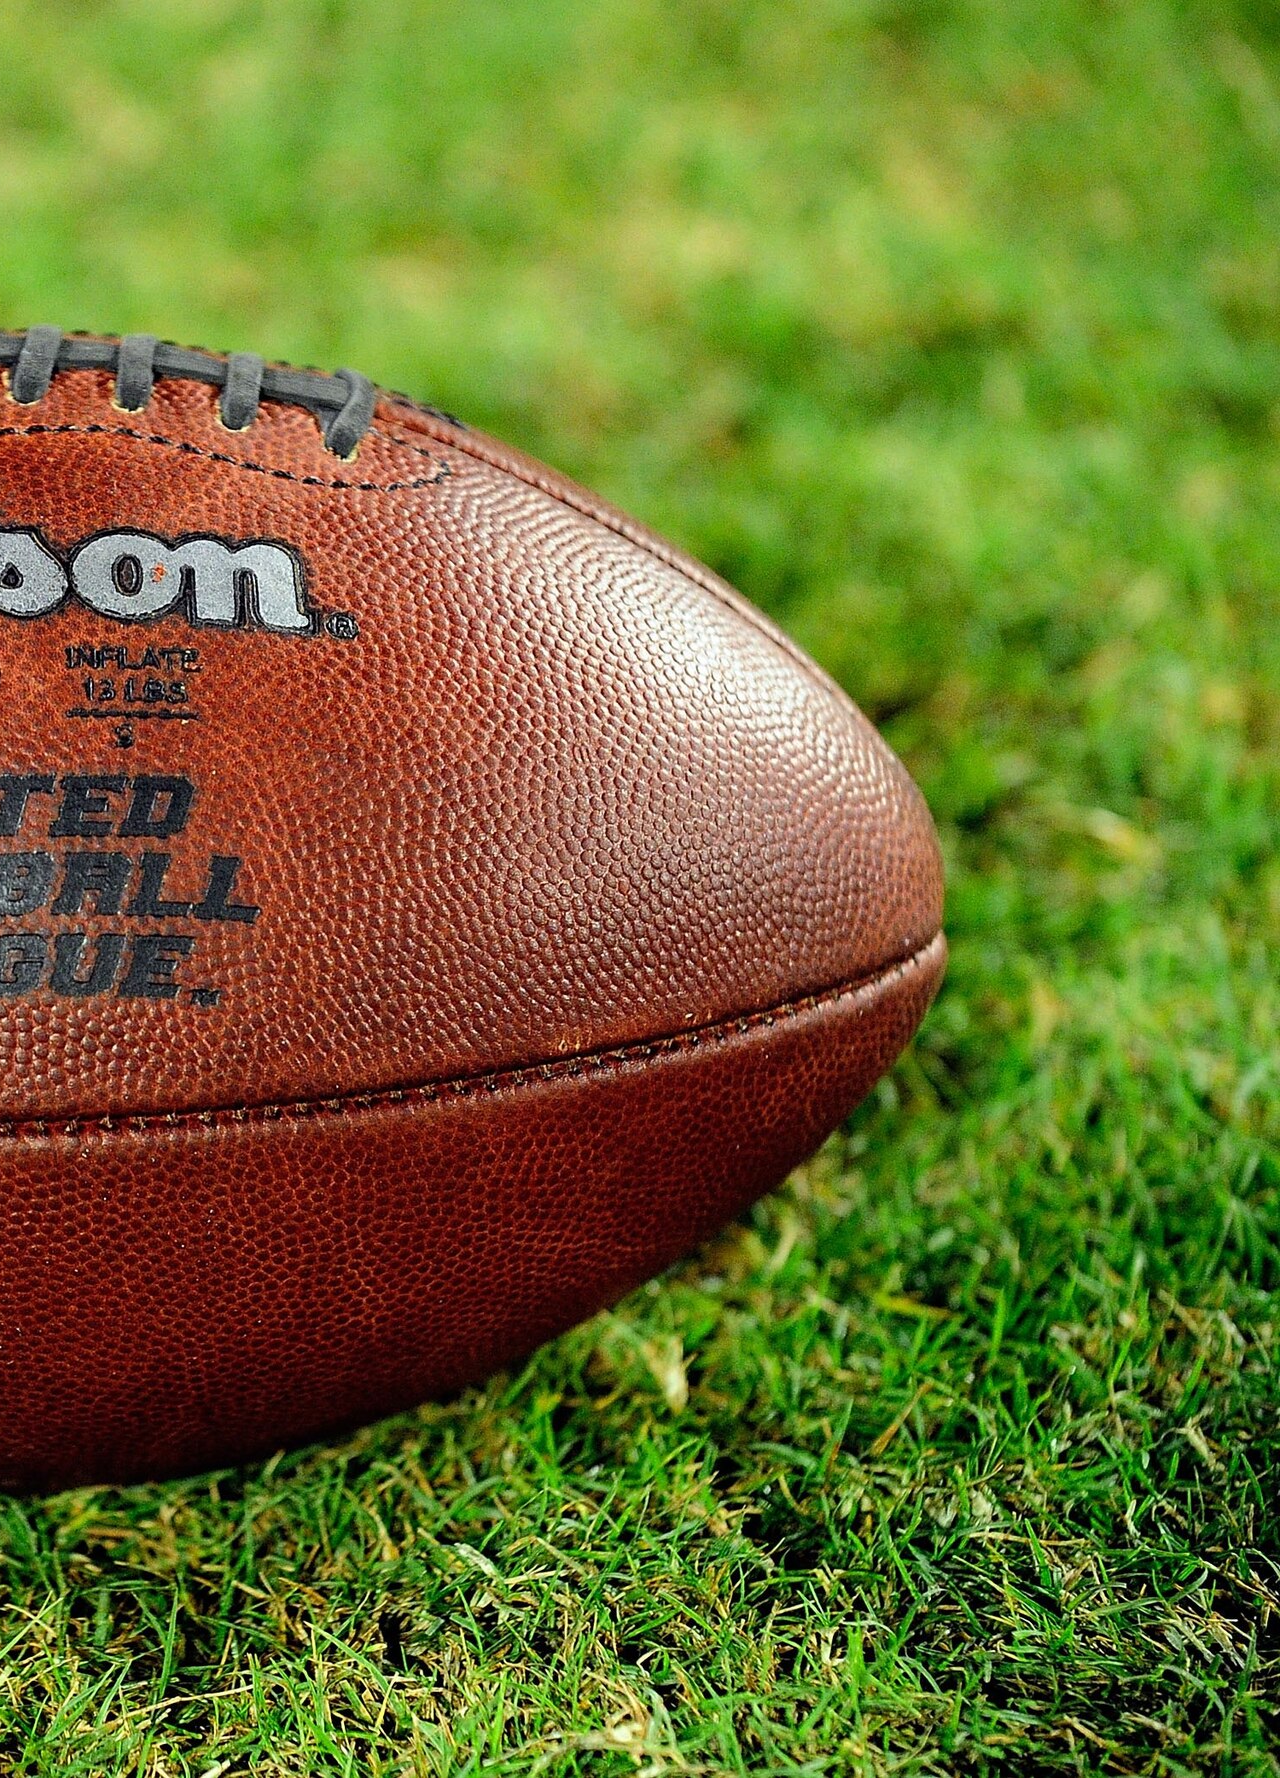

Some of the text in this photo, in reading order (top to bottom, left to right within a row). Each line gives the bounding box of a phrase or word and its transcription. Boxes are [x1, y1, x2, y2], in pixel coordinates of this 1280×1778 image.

[65, 643, 203, 672] INFLATE
[84, 675, 189, 703] 13 LBS
